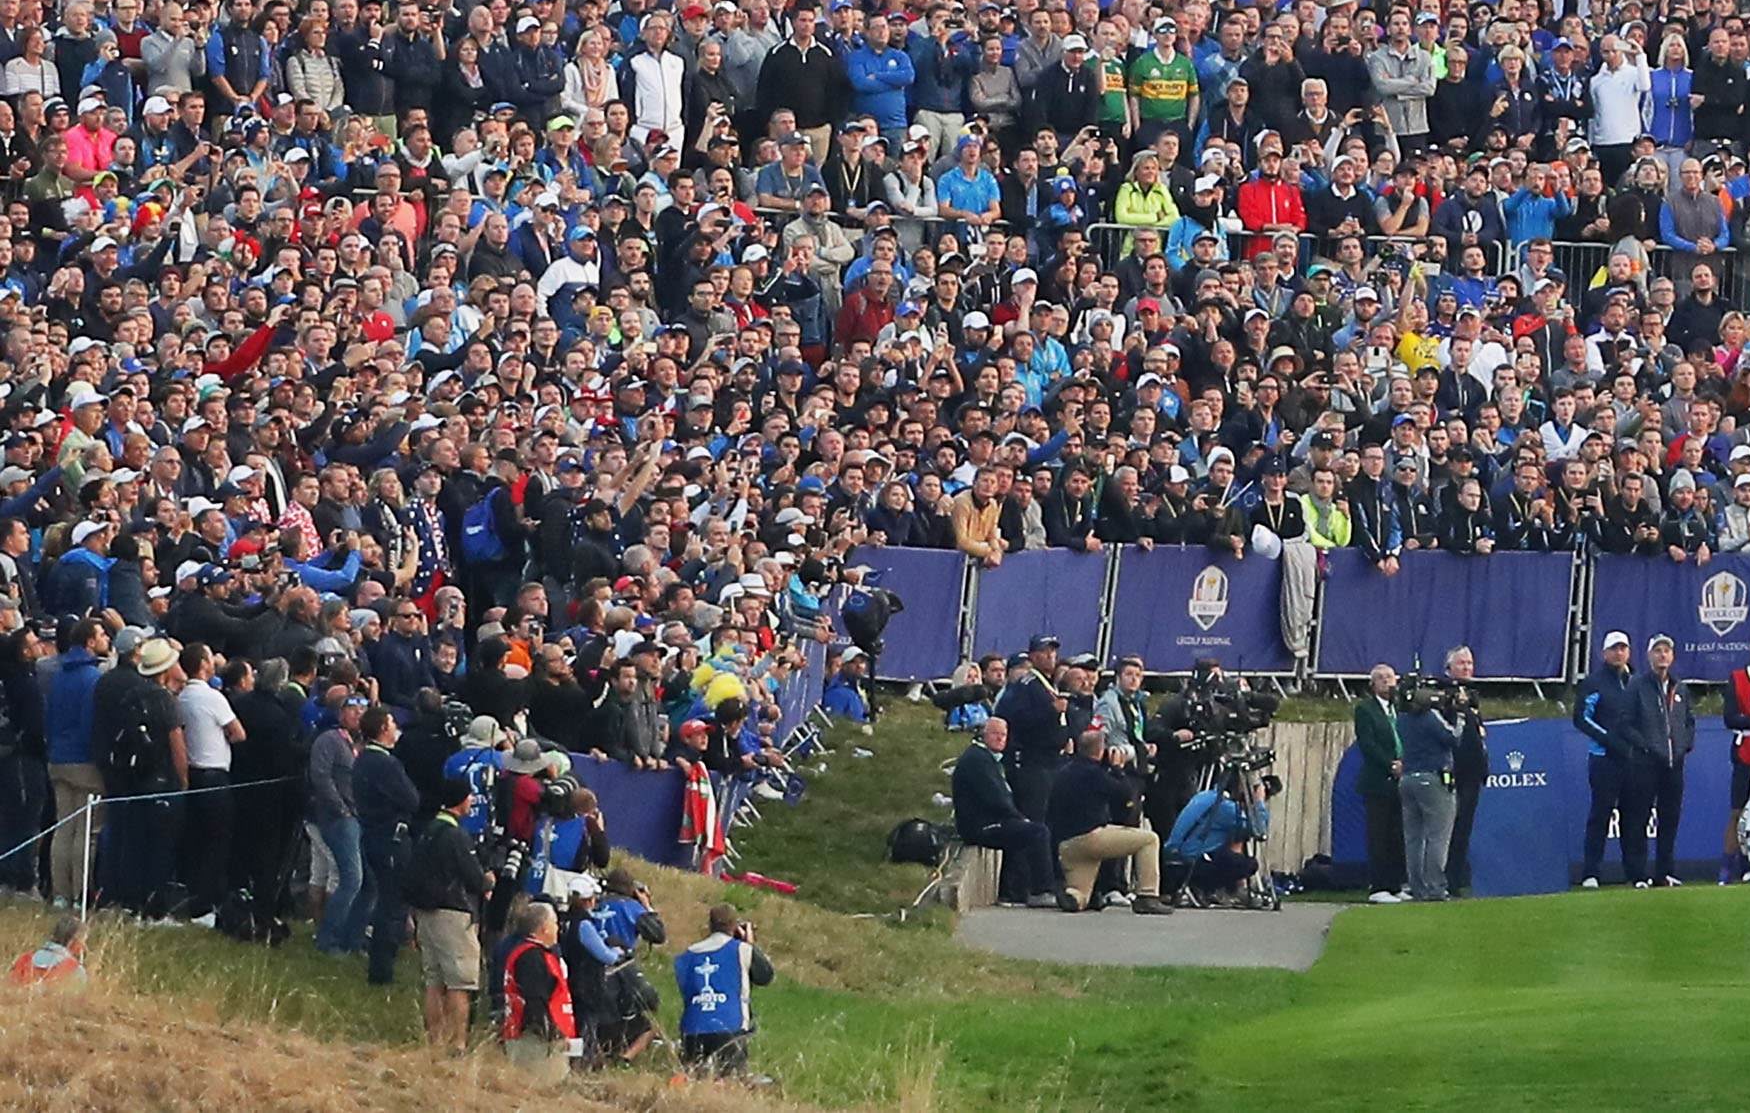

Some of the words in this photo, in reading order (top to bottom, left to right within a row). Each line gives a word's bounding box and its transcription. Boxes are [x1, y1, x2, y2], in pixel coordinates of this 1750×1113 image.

[1486, 773, 1547, 788] ROLEX
[691, 992, 727, 1005] PHOTO
[701, 1001, 716, 1012] 22
